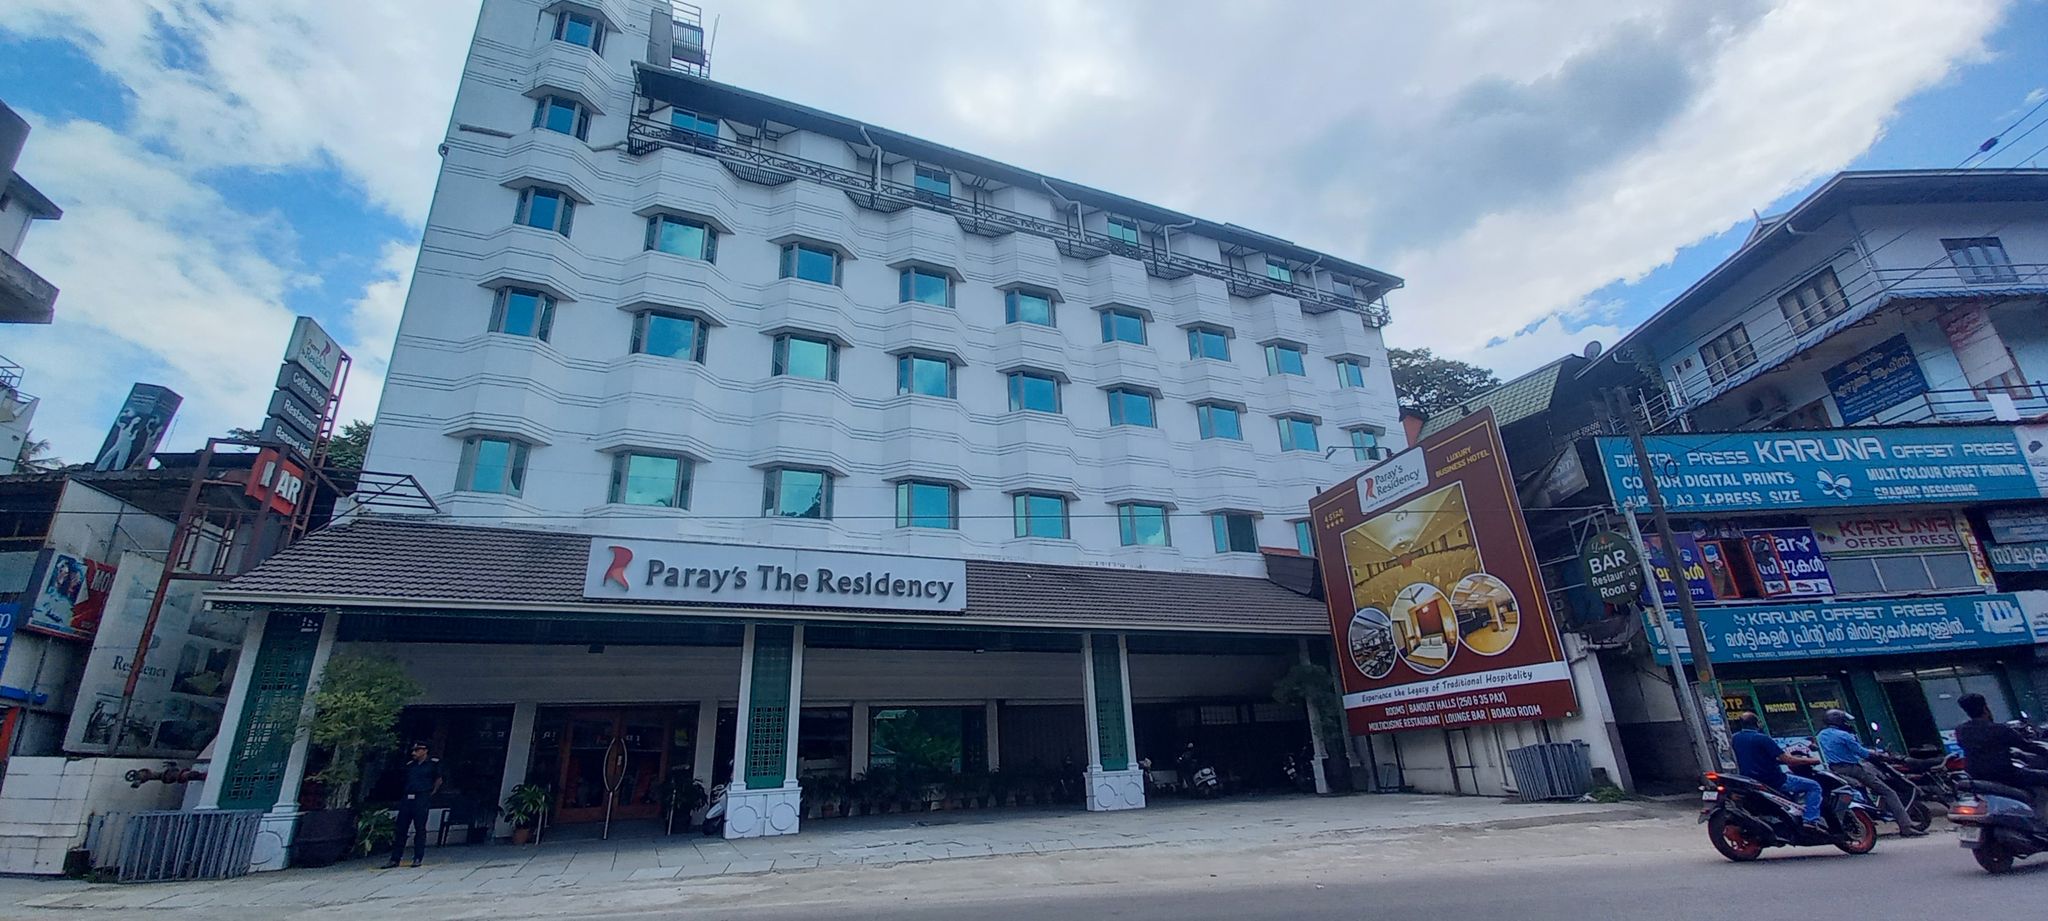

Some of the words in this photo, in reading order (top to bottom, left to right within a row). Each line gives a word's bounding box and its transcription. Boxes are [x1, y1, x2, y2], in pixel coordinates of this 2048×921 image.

[293, 372, 311, 394] Coffee
[311, 387, 326, 408] Shop
[283, 398, 318, 434] Restaurant
[1467, 449, 1490, 465] HOTEL
[1686, 451, 1749, 466] PRESS
[1752, 437, 1887, 464] KARUNA
[1891, 444, 1954, 459] OFFSET
[1961, 442, 2017, 457] PRESS
[1374, 464, 1404, 485] Paray's
[1376, 469, 1420, 497] Residency
[1684, 473, 1741, 488] DIGITAL
[1744, 471, 1796, 486] PRINTS
[1866, 466, 1900, 481] MULTI
[1901, 465, 1944, 480] COLOUR
[1944, 464, 1980, 479] OFFSET
[1980, 463, 2027, 477] PRINTING
[1839, 516, 1954, 538] KARUNA
[1844, 537, 1903, 549] OFFSET
[1912, 533, 1957, 546] PRESS
[1588, 549, 1629, 575] BAR
[645, 559, 748, 594] Paray's
[757, 564, 809, 593] The
[816, 567, 955, 604] Residency
[1748, 609, 1818, 625] KARUNA
[1821, 607, 1884, 621] OFFSET
[1892, 603, 1947, 618] PRESS
[1394, 689, 1406, 697] the
[1407, 685, 1429, 698] Legacy
[1432, 683, 1440, 692] of
[1442, 677, 1483, 690] Traditional
[1485, 670, 1533, 685] Hospitality
[1385, 704, 1406, 717] ROOMS
[1409, 700, 1436, 714] BANQUET
[1436, 697, 1456, 711] HALLS
[1456, 694, 1473, 710] (250
[1479, 693, 1489, 705] 35
[1489, 690, 1508, 705] PAX)
[1403, 714, 1441, 728] RESTAURANT
[1444, 710, 1471, 725] LOUNGE
[1472, 708, 1487, 721] BAR
[1490, 706, 1518, 719] BOARD
[1517, 704, 1542, 717] ROOM
